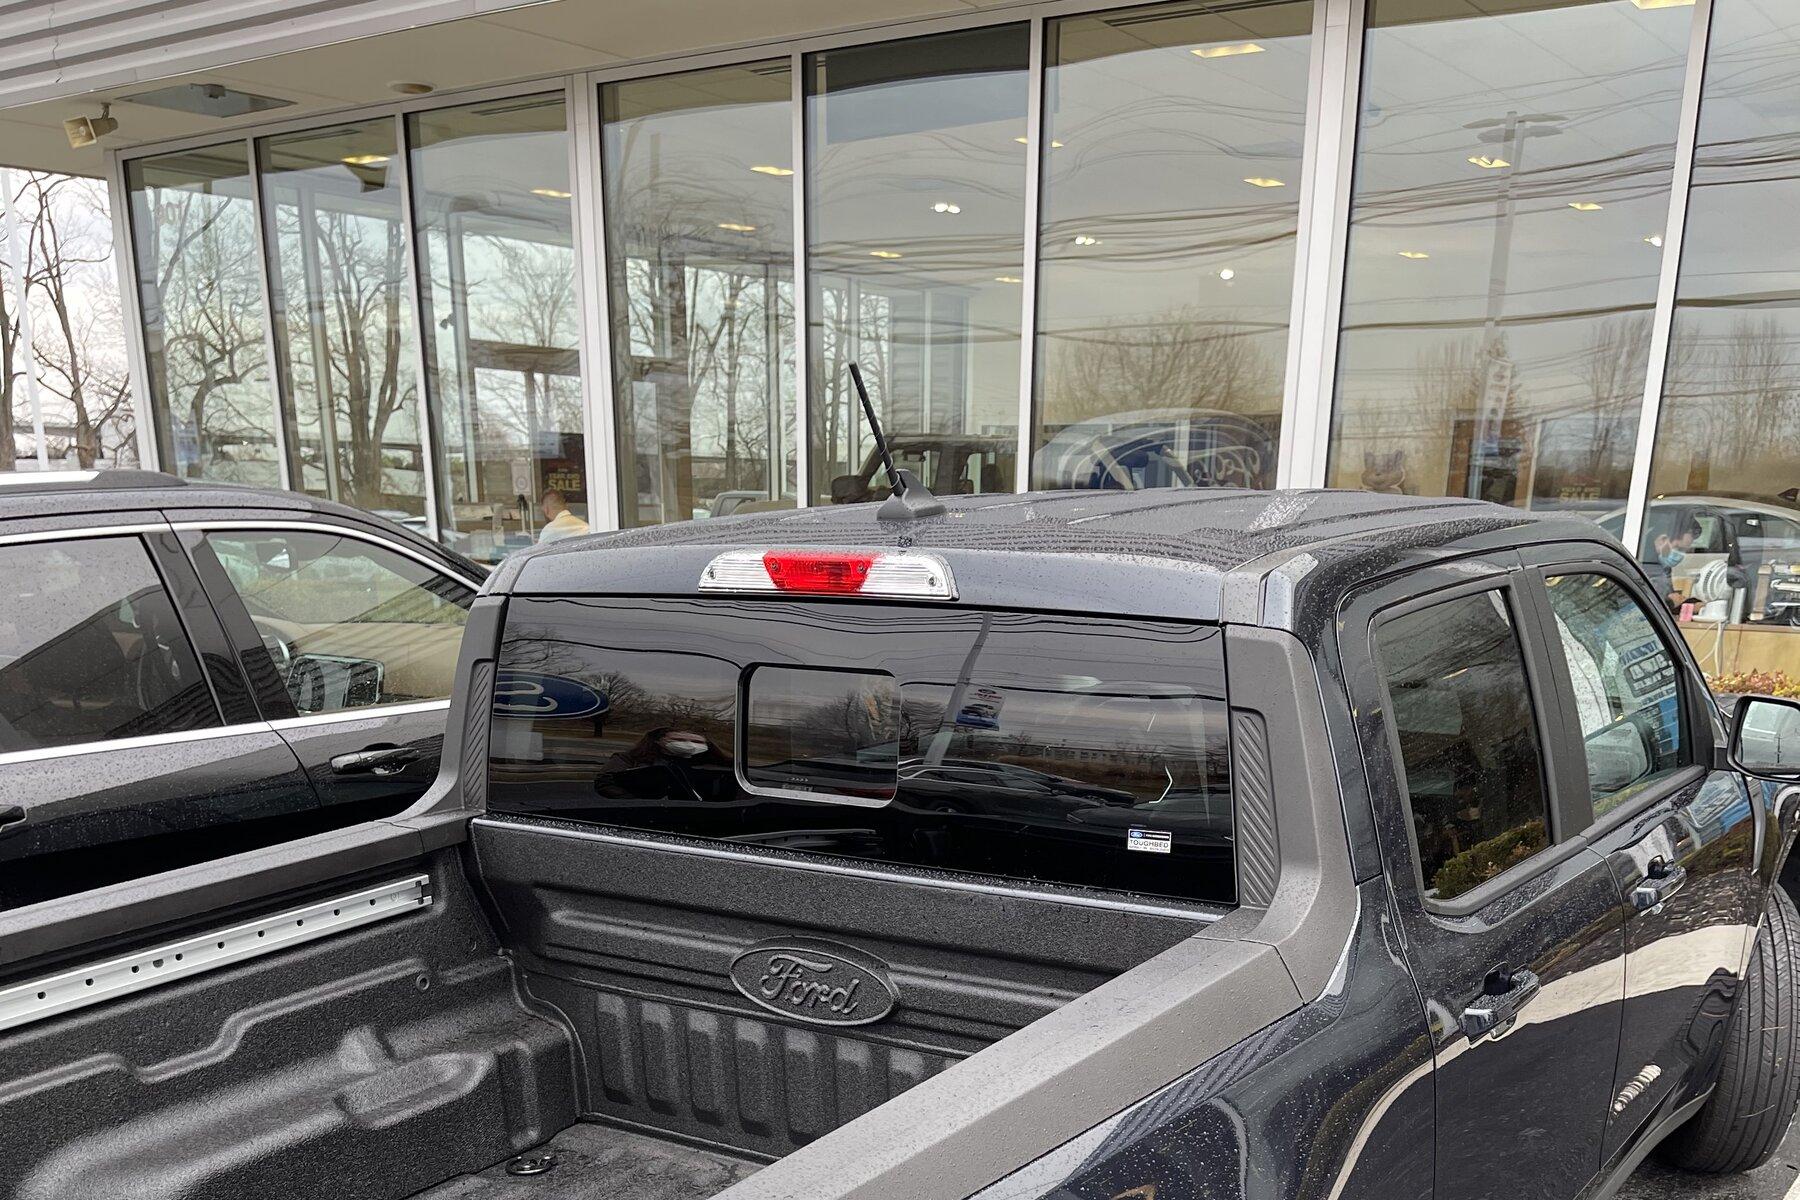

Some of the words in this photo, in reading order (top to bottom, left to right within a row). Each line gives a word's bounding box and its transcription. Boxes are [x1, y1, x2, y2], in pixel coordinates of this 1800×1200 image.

[548, 479, 582, 491] SALE
[1129, 839, 1169, 849] TOUGHBED
[759, 953, 861, 1015] Ford
